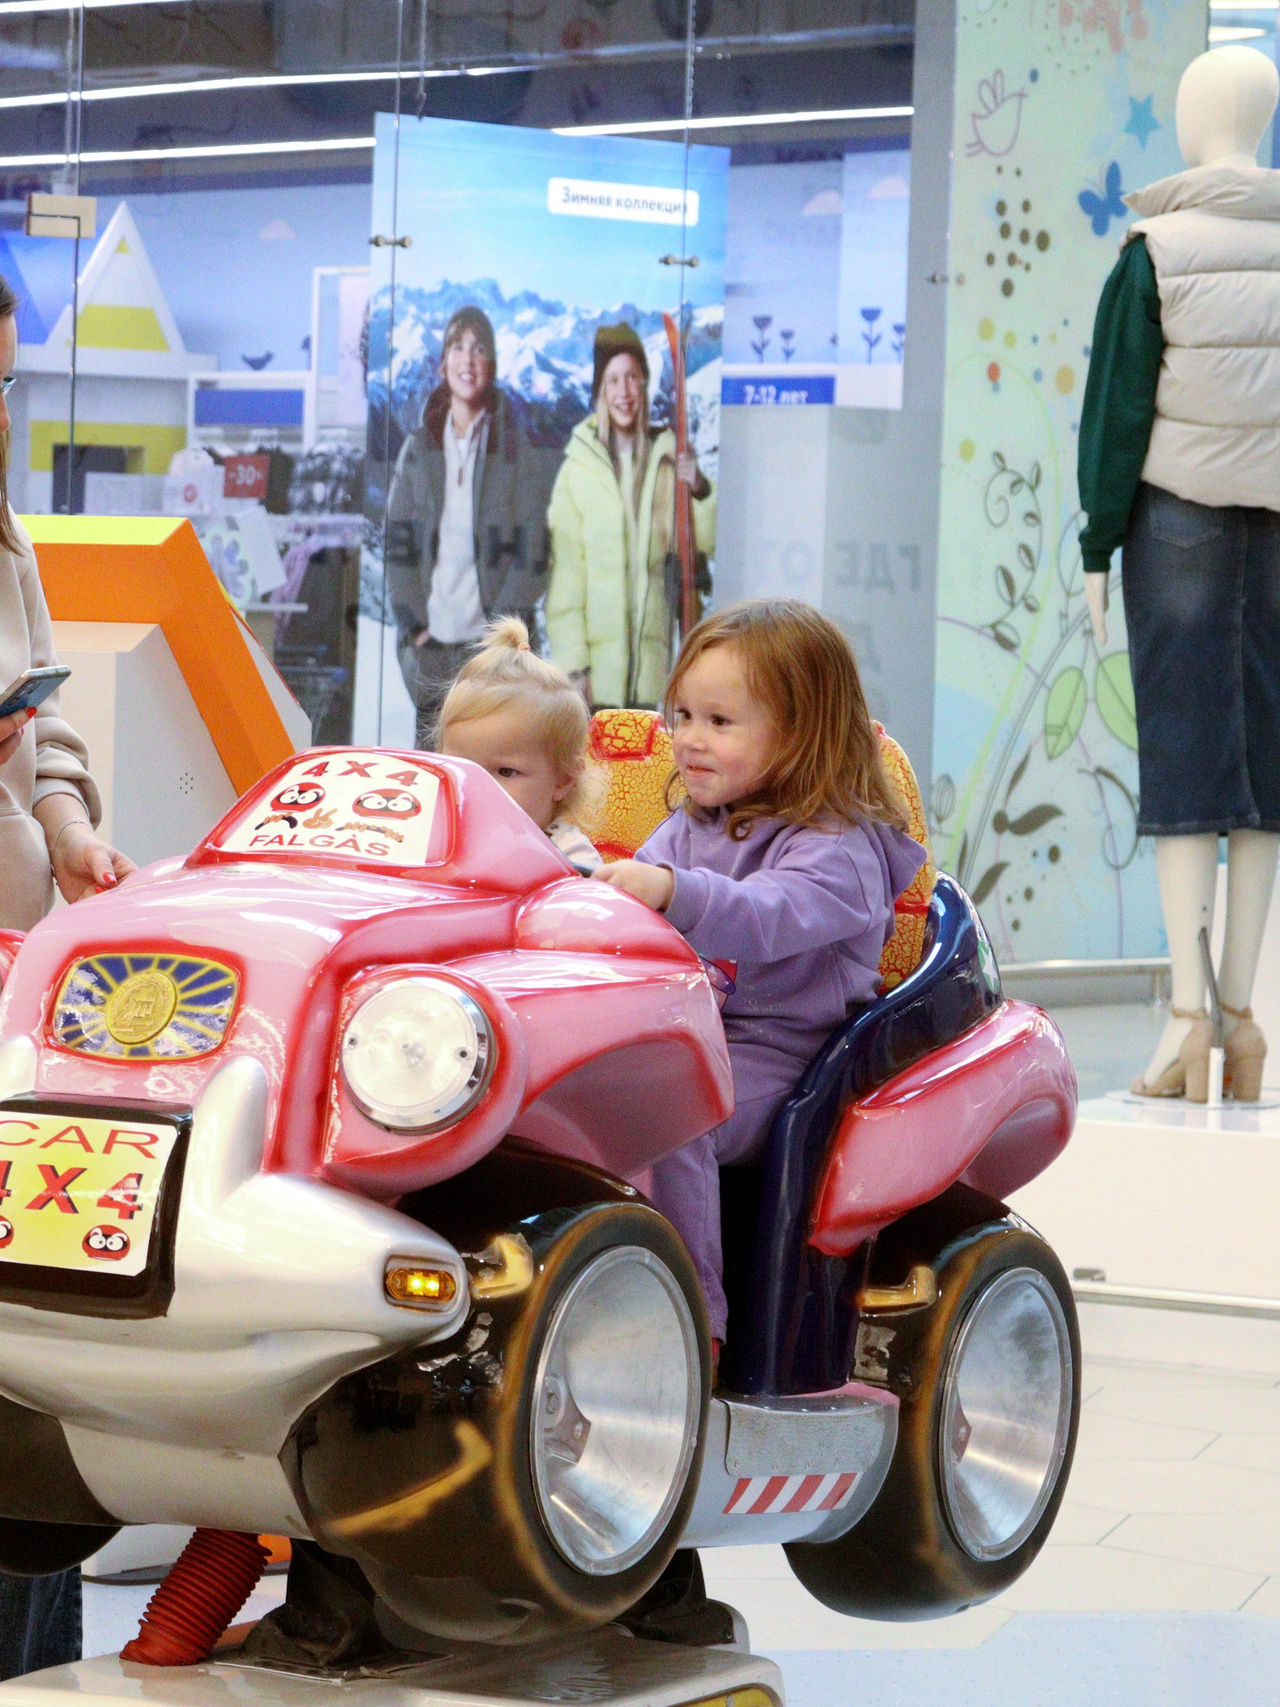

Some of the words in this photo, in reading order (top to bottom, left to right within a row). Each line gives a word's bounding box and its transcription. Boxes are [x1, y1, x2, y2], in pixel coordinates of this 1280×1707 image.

[561, 186, 613, 208] Зимняя
[616, 196, 688, 215] коллекция
[301, 761, 330, 778] 4
[386, 769, 419, 788] 4
[96, 1172, 144, 1220] 4
